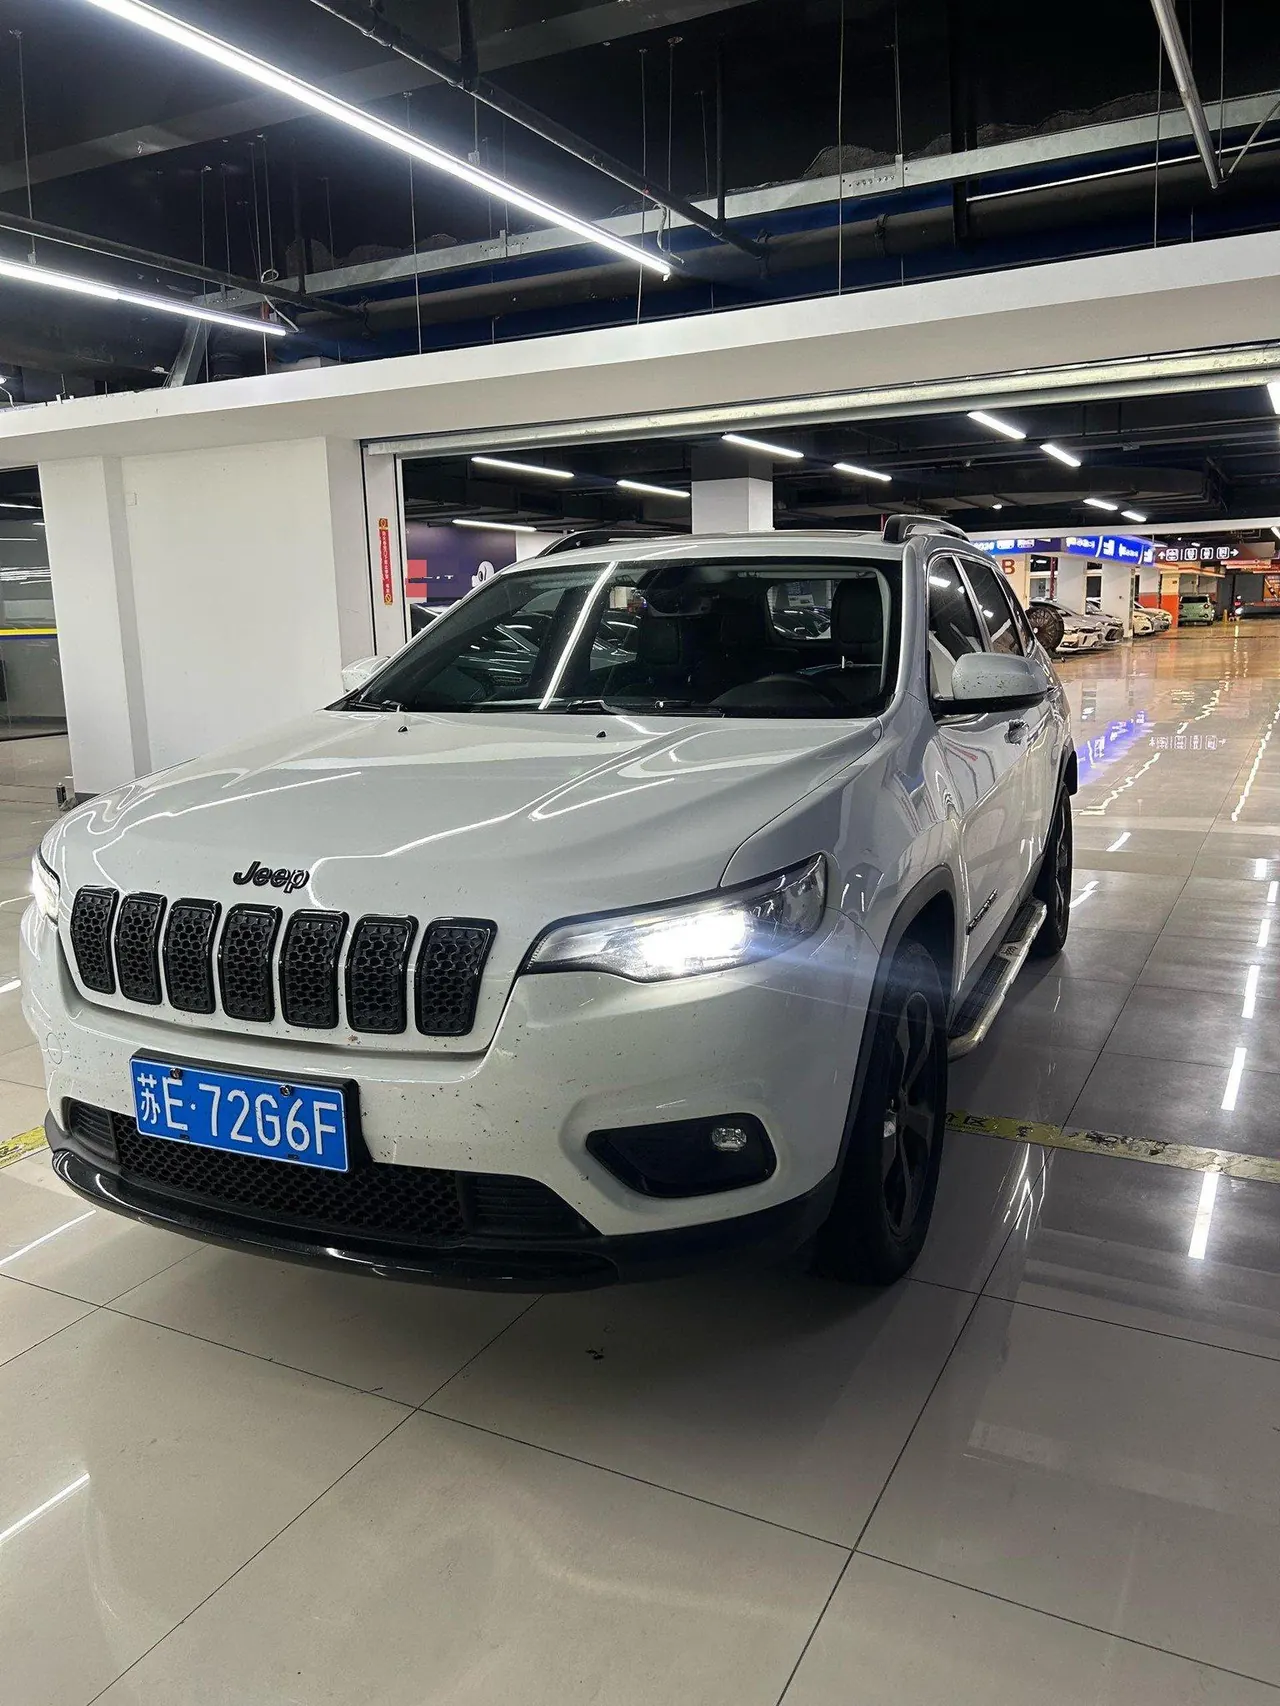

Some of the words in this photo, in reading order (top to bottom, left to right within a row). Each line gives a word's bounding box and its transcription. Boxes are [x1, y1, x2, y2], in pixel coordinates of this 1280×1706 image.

[1001, 559, 1016, 575] B
[233, 861, 311, 893] Jeep
[136, 1072, 339, 1156] 苏E·72G6F
